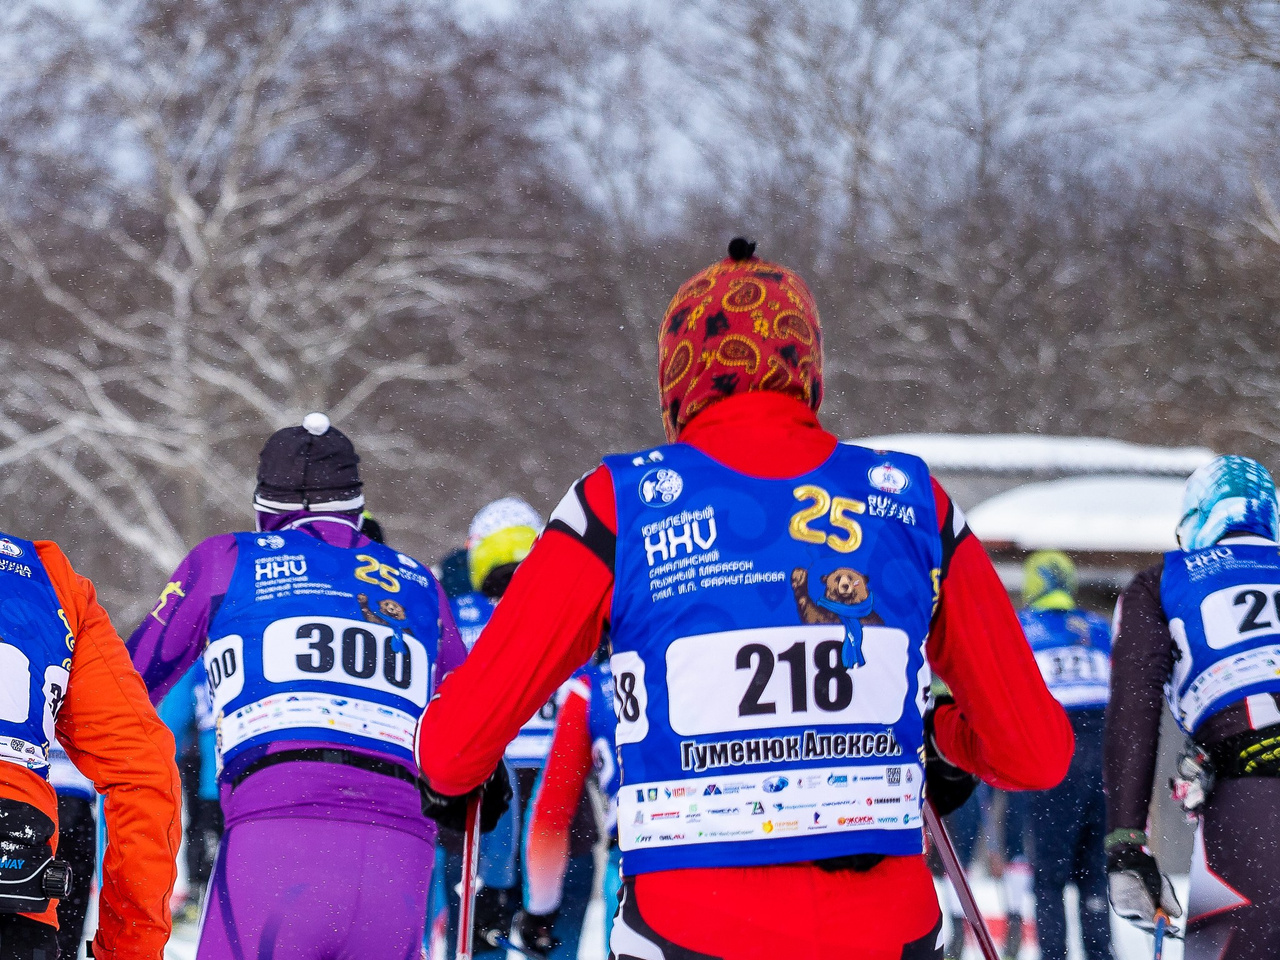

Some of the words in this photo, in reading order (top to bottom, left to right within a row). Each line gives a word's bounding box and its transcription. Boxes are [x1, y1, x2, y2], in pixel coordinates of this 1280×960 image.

[788, 484, 866, 553] 25
[354, 554, 400, 593] 25
[205, 647, 237, 698] 00
[295, 622, 412, 690] 300
[735, 639, 853, 717] 218
[681, 741, 799, 772] Гуменюк
